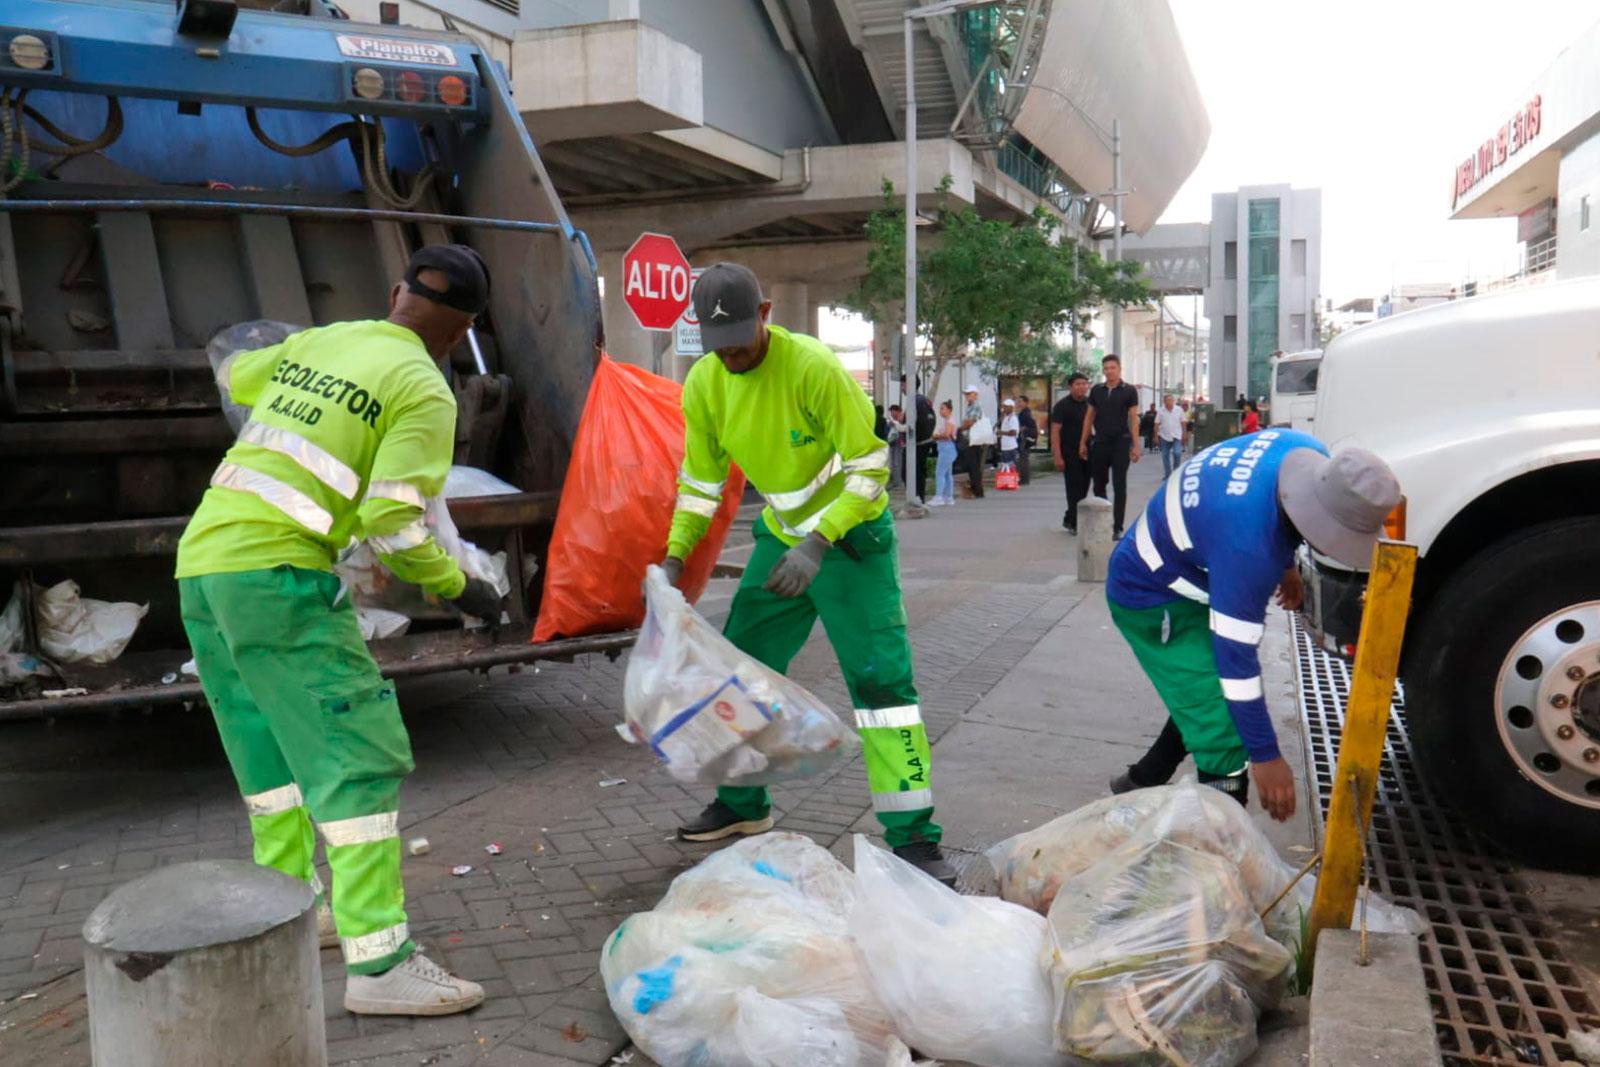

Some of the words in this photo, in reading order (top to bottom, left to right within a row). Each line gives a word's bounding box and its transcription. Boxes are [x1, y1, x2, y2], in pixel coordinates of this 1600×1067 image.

[626, 259, 688, 302] ALTO
[271, 359, 382, 429] ECOLECTOR
[1209, 447, 1239, 468] DE
[1226, 431, 1280, 496] GESTOR
